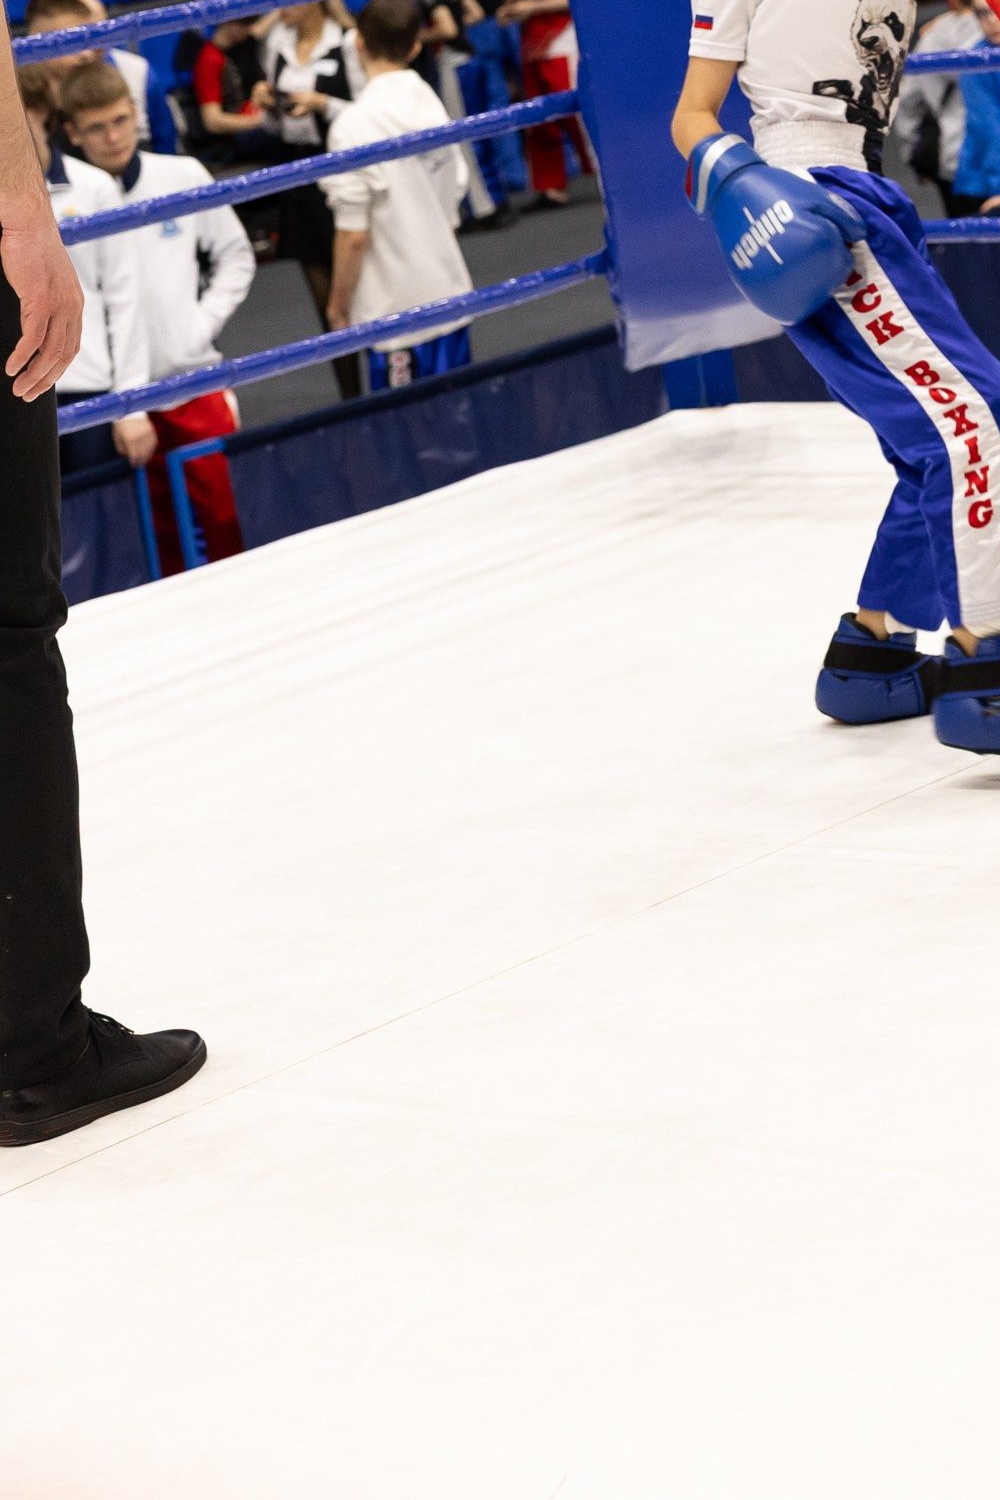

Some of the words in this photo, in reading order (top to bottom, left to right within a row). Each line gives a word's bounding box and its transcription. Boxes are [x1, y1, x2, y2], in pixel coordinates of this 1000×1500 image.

[731, 199, 795, 271] clinch
[845, 269, 905, 346] CK
[903, 360, 994, 529] BOXING
